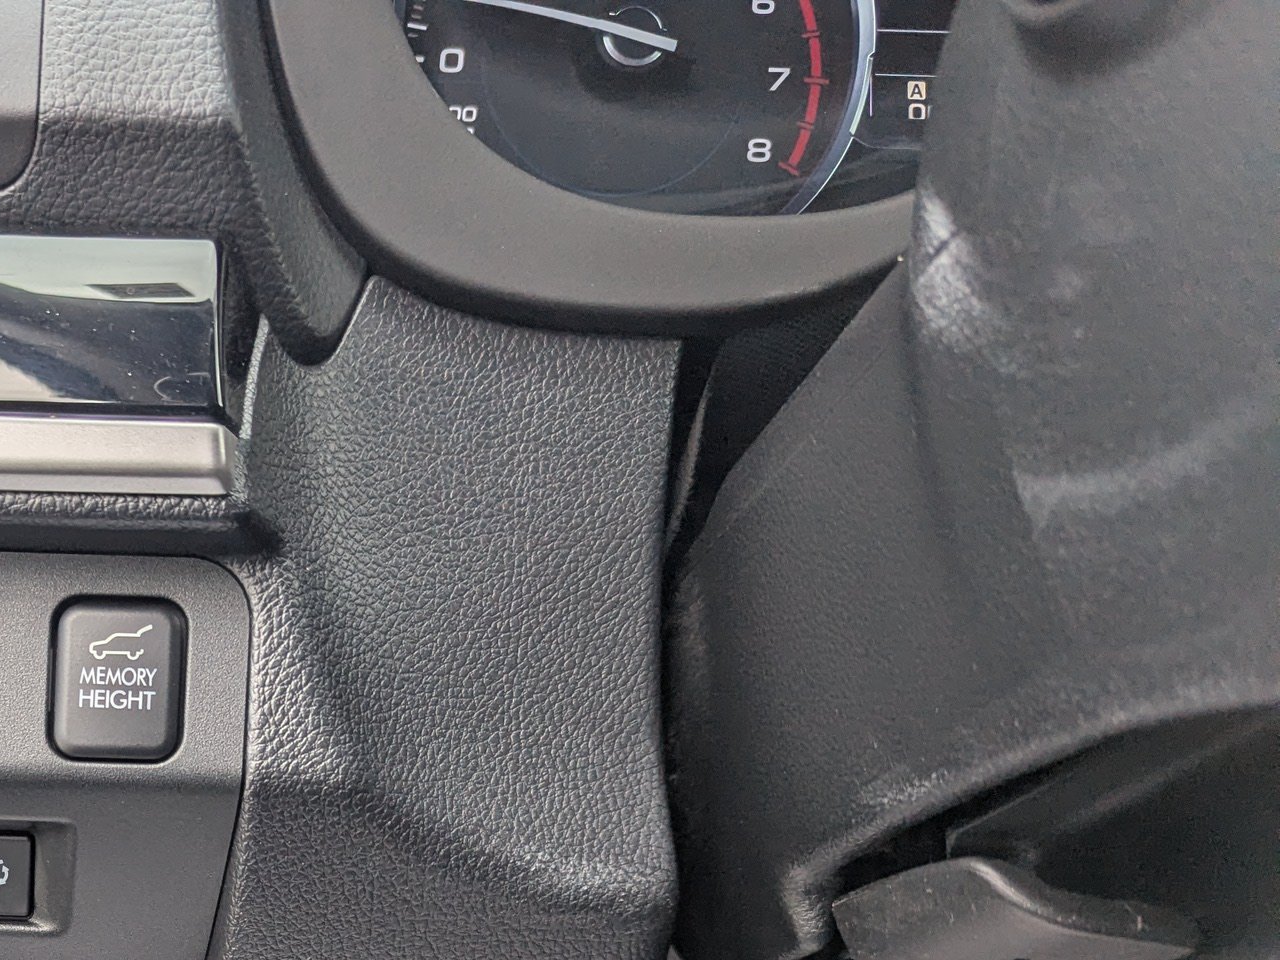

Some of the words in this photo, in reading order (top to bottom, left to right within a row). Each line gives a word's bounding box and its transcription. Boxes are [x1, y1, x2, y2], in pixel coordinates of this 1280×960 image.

[439, 48, 464, 73] 0
[768, 67, 791, 92] 7
[909, 82, 924, 99] A
[746, 138, 772, 163] 8
[79, 666, 157, 687] MEMORY
[78, 688, 156, 710] HEIGHT
